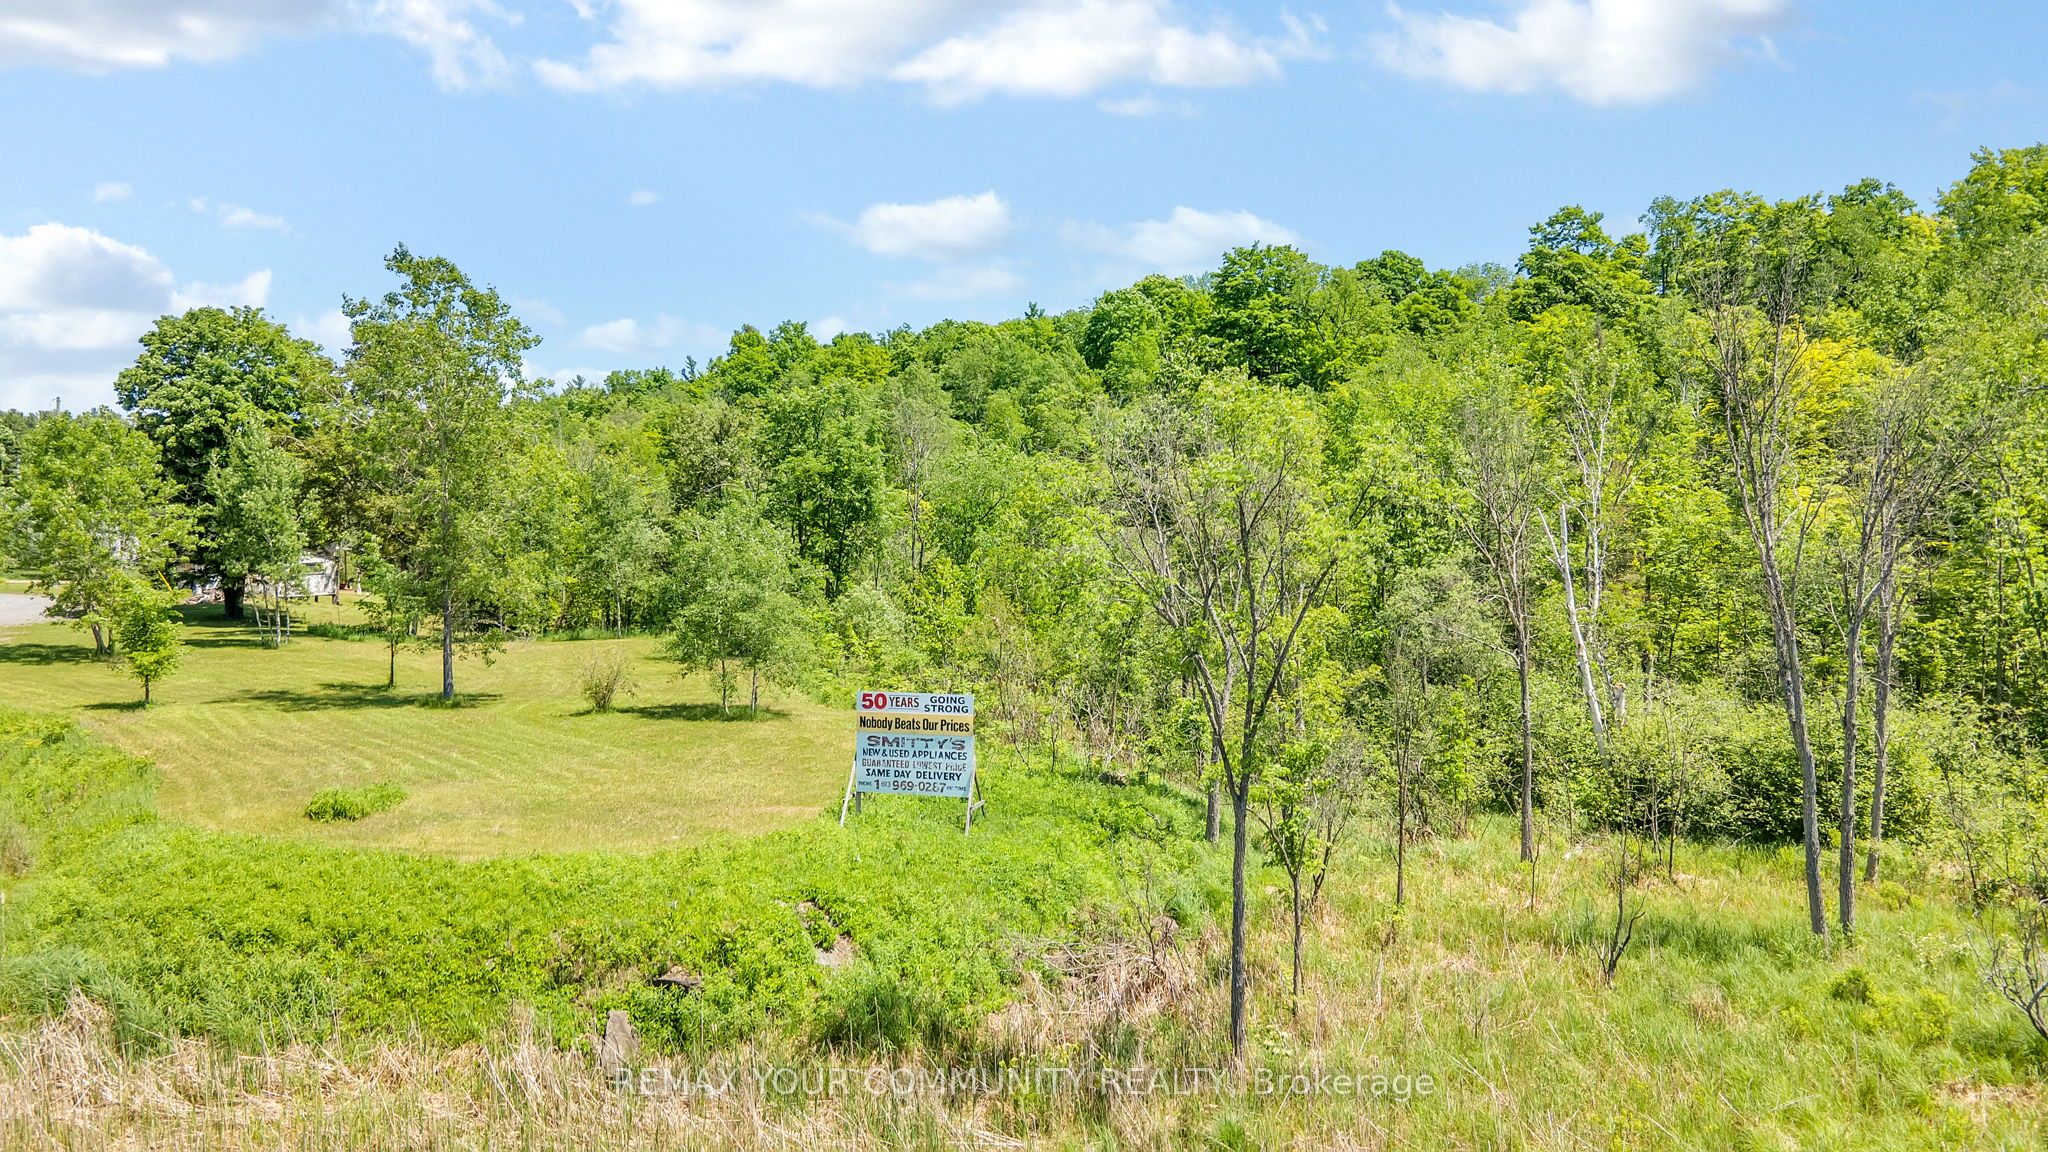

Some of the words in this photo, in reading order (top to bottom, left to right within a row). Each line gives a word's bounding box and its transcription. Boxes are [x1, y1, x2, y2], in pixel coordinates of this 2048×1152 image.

[861, 692, 888, 710] 50
[889, 696, 920, 708] YEARS
[929, 695, 966, 705] GOING
[924, 704, 969, 714] STRONG
[859, 716, 892, 731] Nobody
[894, 717, 921, 731] Beats
[922, 718, 939, 731] Our
[940, 719, 970, 733] Prices
[866, 735, 966, 751] SMITTY'S
[862, 748, 881, 757] NEW
[881, 748, 888, 757] &
[888, 749, 910, 758] USED
[911, 750, 968, 761] APPLIANCES
[861, 758, 910, 769] GUARANTEED
[865, 768, 891, 778] SAME
[893, 769, 912, 779] DAY
[915, 771, 963, 781] DELIVERY
[874, 779, 880, 789] 1
